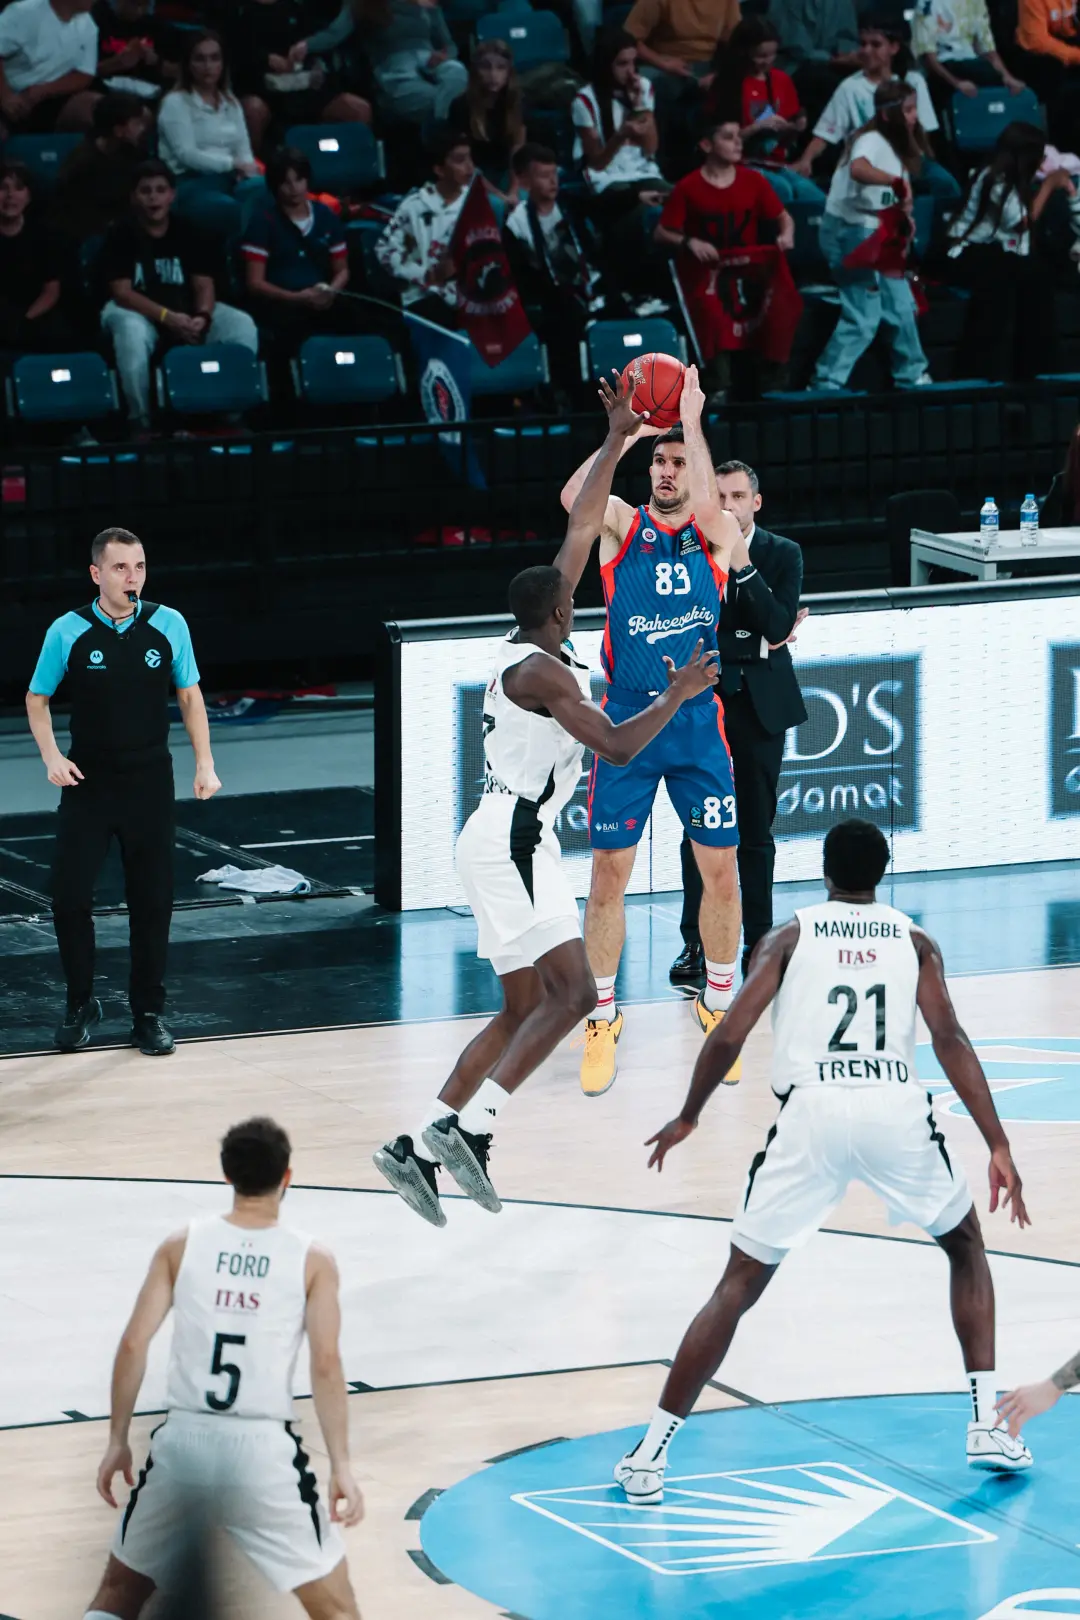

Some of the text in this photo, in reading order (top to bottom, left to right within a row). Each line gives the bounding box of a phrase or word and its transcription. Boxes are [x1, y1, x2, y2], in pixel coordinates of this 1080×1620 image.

[655, 562, 691, 596] 83
[782, 680, 904, 761] D'S
[602, 821, 619, 830] BAU
[703, 795, 737, 829] 83
[814, 920, 902, 939] MAWUGBE
[838, 948, 877, 965] ITAS
[827, 983, 886, 1053] 21
[815, 1059, 909, 1083] TRENTO
[216, 1251, 270, 1278] FORD
[215, 1289, 260, 1310] ITAS
[205, 1332, 246, 1411] 5
